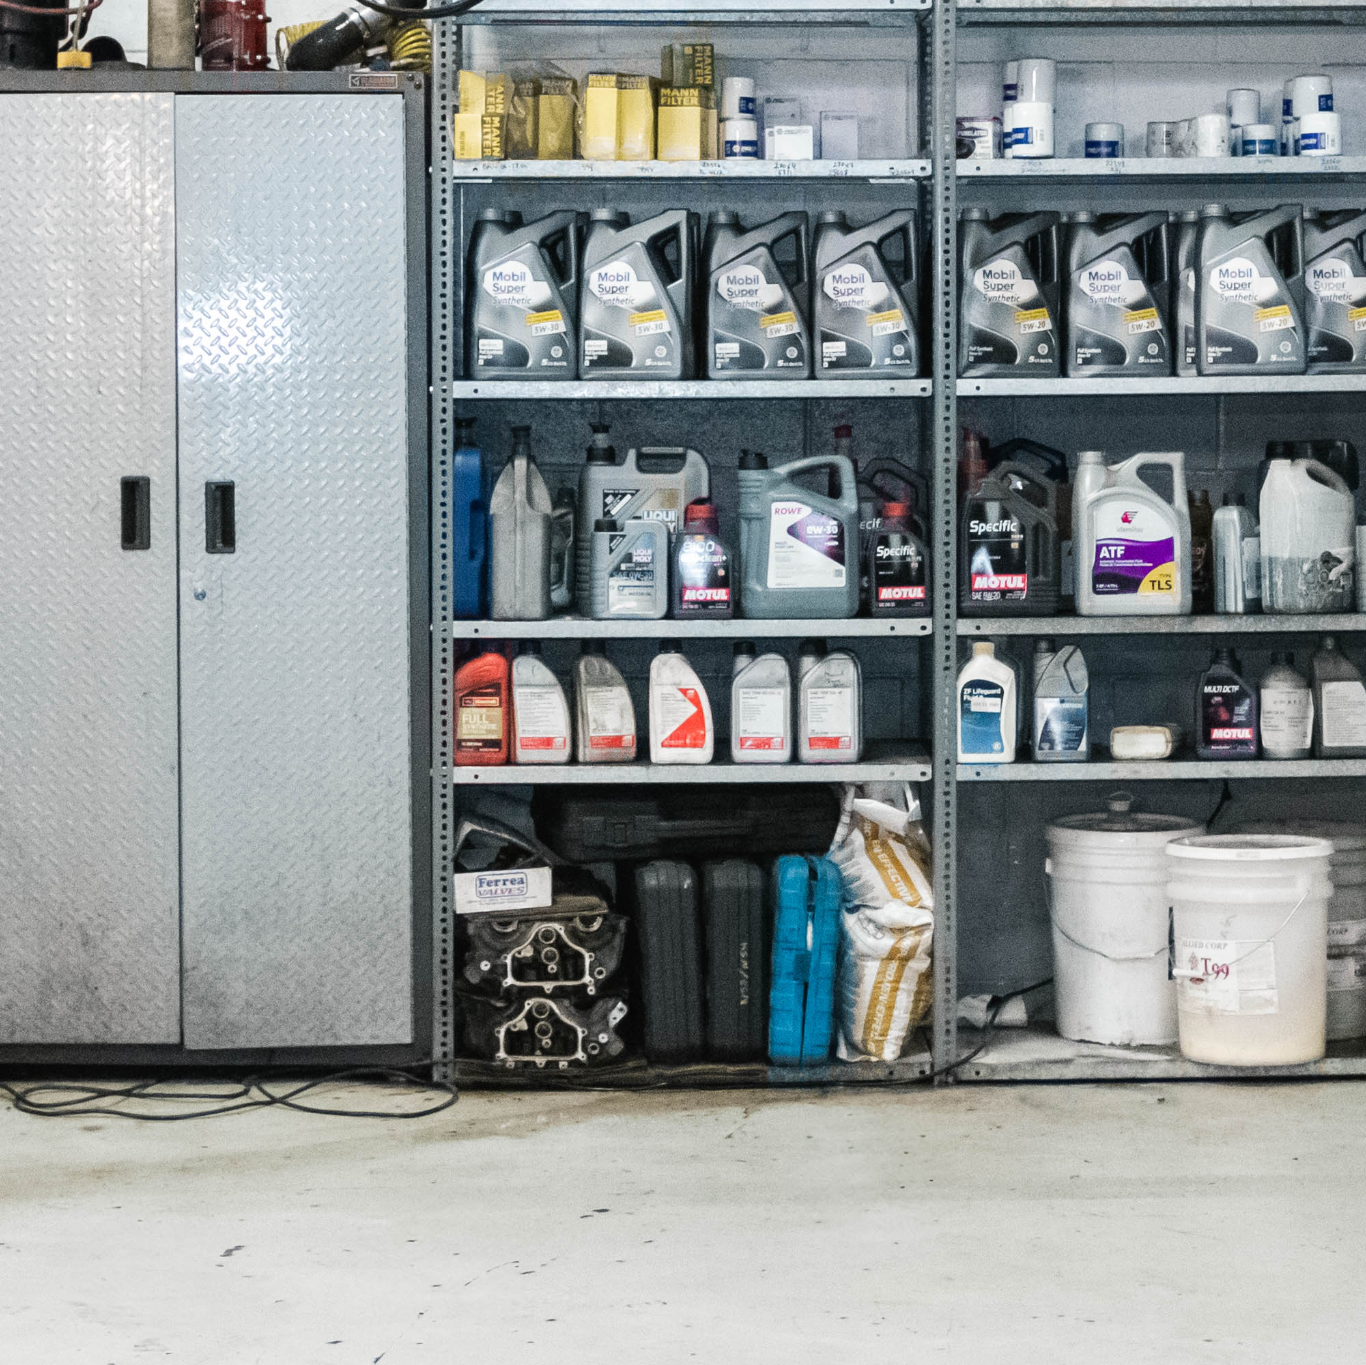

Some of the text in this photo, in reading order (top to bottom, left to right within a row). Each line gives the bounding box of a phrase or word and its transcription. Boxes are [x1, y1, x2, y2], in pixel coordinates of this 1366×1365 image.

[695, 45, 704, 85] FILTER
[704, 45, 712, 85] MANN
[660, 88, 699, 97] MANN
[660, 96, 699, 106] FILTER
[482, 116, 492, 156] FILTER
[491, 116, 501, 157] MANN
[492, 271, 526, 282] Mobil
[598, 272, 630, 282] Mobil
[832, 273, 865, 285] Mobil
[982, 269, 1015, 280] Mobil
[1088, 271, 1122, 282] Mobil
[1218, 268, 1253, 279] Mobil
[1313, 268, 1346, 279] Mobil
[726, 275, 760, 285] Mobil
[1219, 280, 1252, 290] Super
[1313, 280, 1345, 290] Super
[492, 284, 526, 294] Super
[598, 284, 629, 294] Super
[832, 285, 865, 297] Super
[982, 281, 1015, 292] Super
[1088, 283, 1121, 294] Super
[726, 287, 759, 298] Super
[1219, 293, 1258, 303] Synthetic
[1314, 293, 1353, 303] Synthetic
[492, 296, 532, 307] Synthetic
[598, 296, 635, 307] Synthetic
[727, 299, 766, 309] Synthetic
[834, 298, 872, 309] Synthetic
[982, 293, 1021, 304] Synthetic
[1088, 295, 1128, 305] Synthetic
[534, 323, 560, 333] 5W-30
[638, 323, 663, 333] 5W-30
[1022, 320, 1046, 332] 5W-20
[1130, 320, 1156, 332] 5W-20
[1262, 319, 1288, 330] 5W-20
[643, 511, 676, 521] LIQUI
[775, 507, 803, 515] ROWE
[806, 525, 838, 535] 0W-30
[970, 520, 1017, 535] Specific
[876, 545, 915, 560] Specific
[1099, 546, 1126, 558] ATF
[974, 574, 1025, 588] MOTUL
[1149, 579, 1172, 590] TLS
[684, 589, 728, 600] MOTUL
[880, 588, 924, 599] MOTUL
[972, 688, 1002, 697] Lifeguard
[462, 714, 489, 724] FULL
[1212, 728, 1252, 739] MOTUL
[478, 877, 525, 888] Ferrea
[478, 886, 525, 896] VALVES
[1205, 942, 1228, 950] CORP
